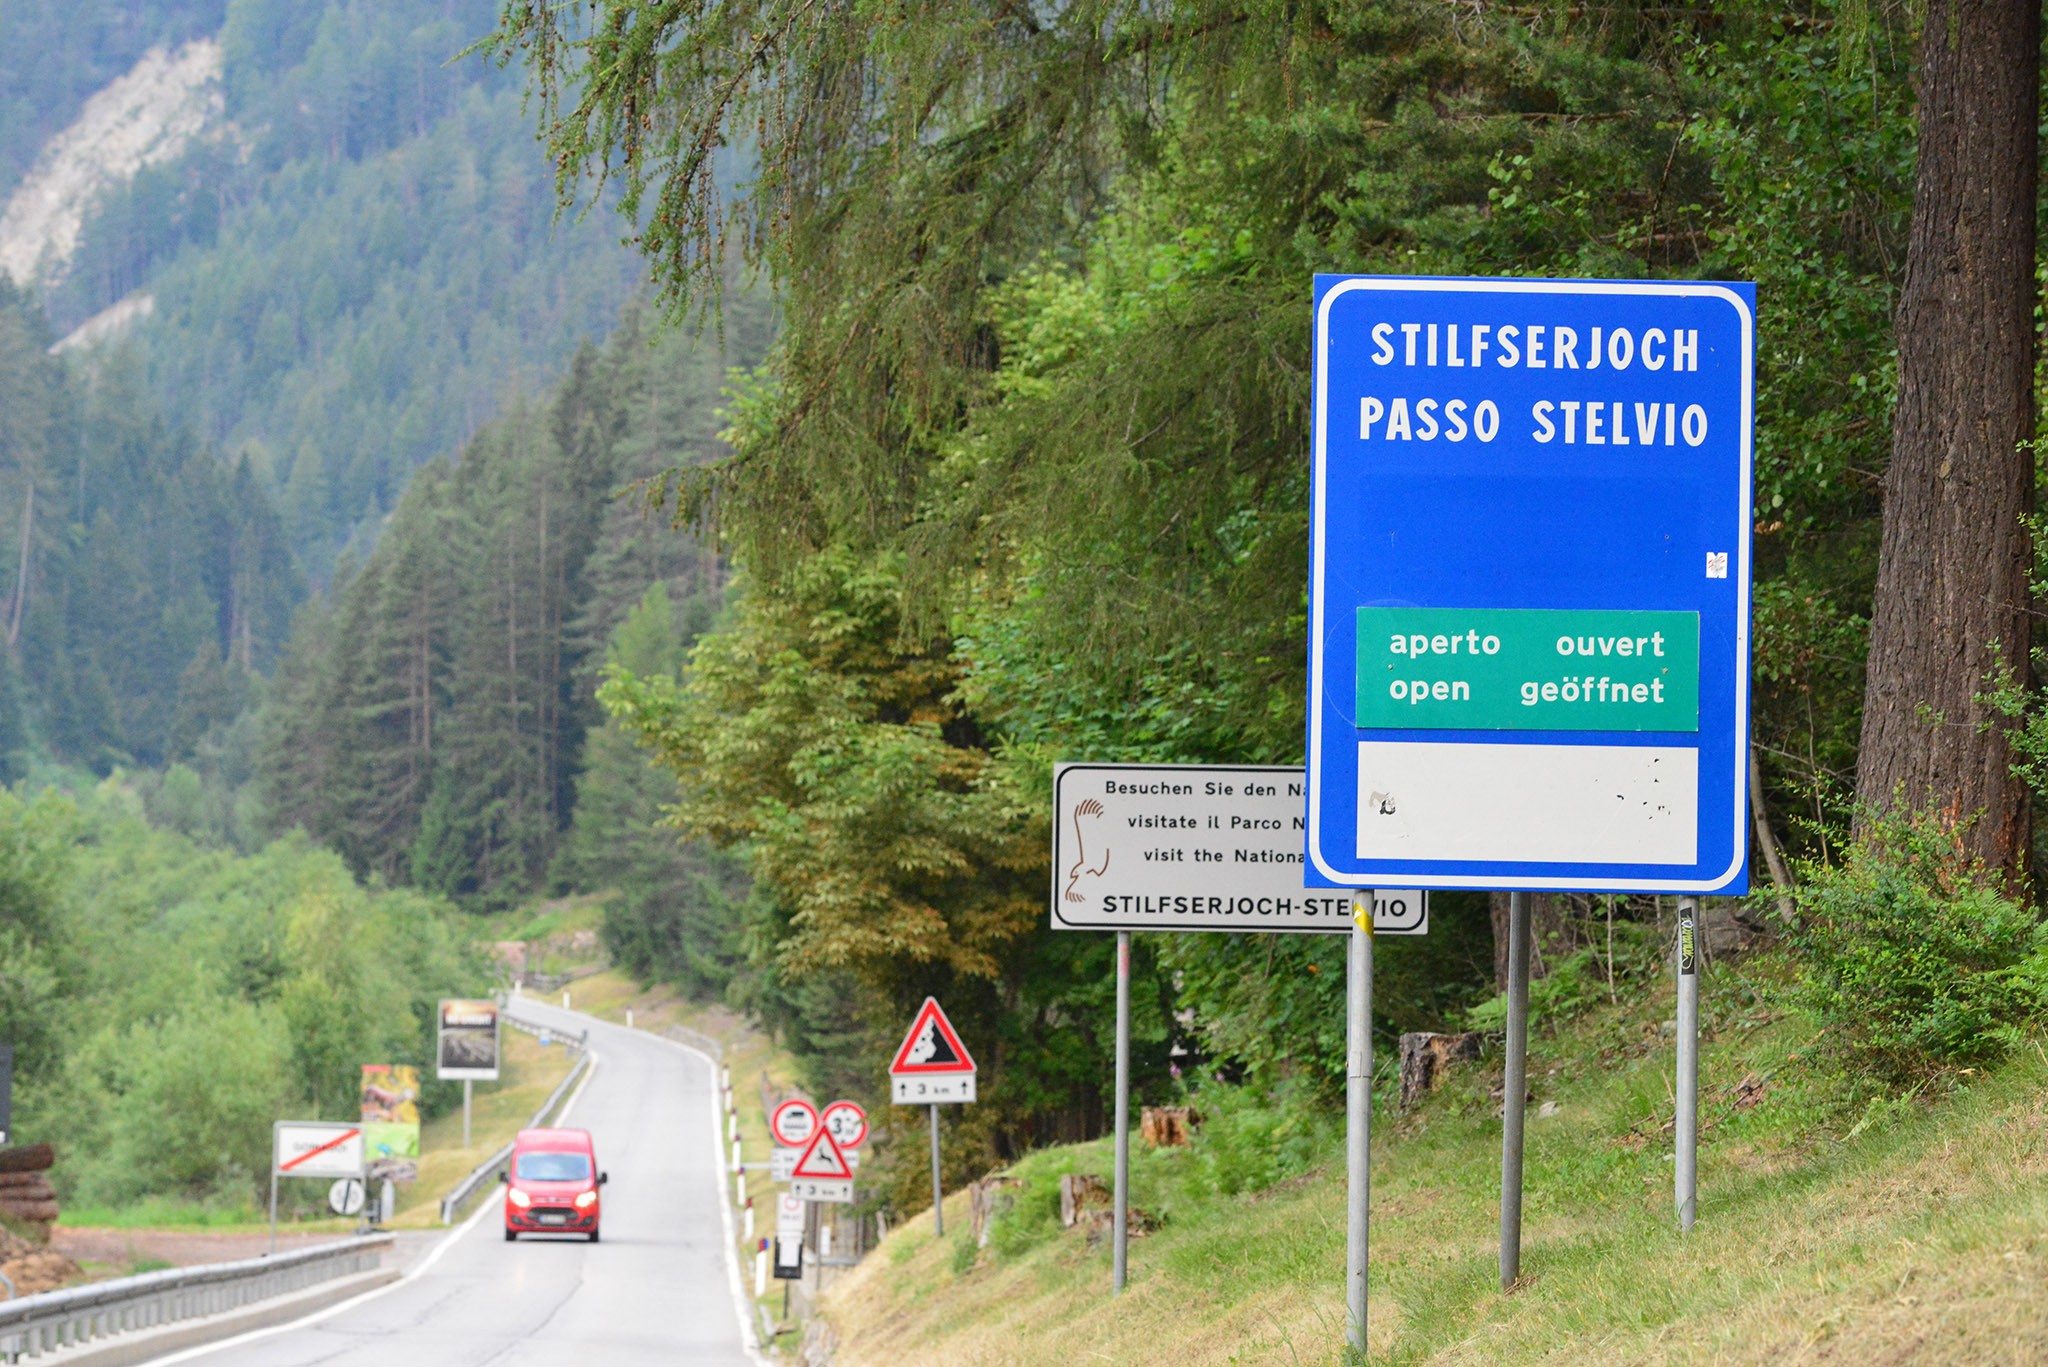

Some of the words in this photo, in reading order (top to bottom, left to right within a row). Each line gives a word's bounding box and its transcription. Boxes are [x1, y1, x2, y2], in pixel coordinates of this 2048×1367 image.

[1371, 323, 1697, 371] STILFSERJOCH
[1360, 397, 1499, 442] PASSO
[1533, 401, 1707, 446] STELVIO
[1390, 630, 1500, 658] aperto
[1557, 632, 1664, 656] ouvert
[1390, 680, 1469, 704] open
[1521, 677, 1664, 705] geöffnet
[1105, 781, 1193, 795] Besuchen
[1204, 782, 1234, 796] Sie
[1244, 783, 1276, 796] den
[1128, 815, 1197, 829] visitate
[1208, 816, 1220, 829] il
[1231, 816, 1282, 830] Parco
[1144, 849, 1183, 862] visit
[1194, 850, 1223, 863] the
[1234, 850, 1303, 864] Nationa
[1103, 895, 1407, 917] STILFSERJOCH-STEIO
[917, 1083, 926, 1095] 3
